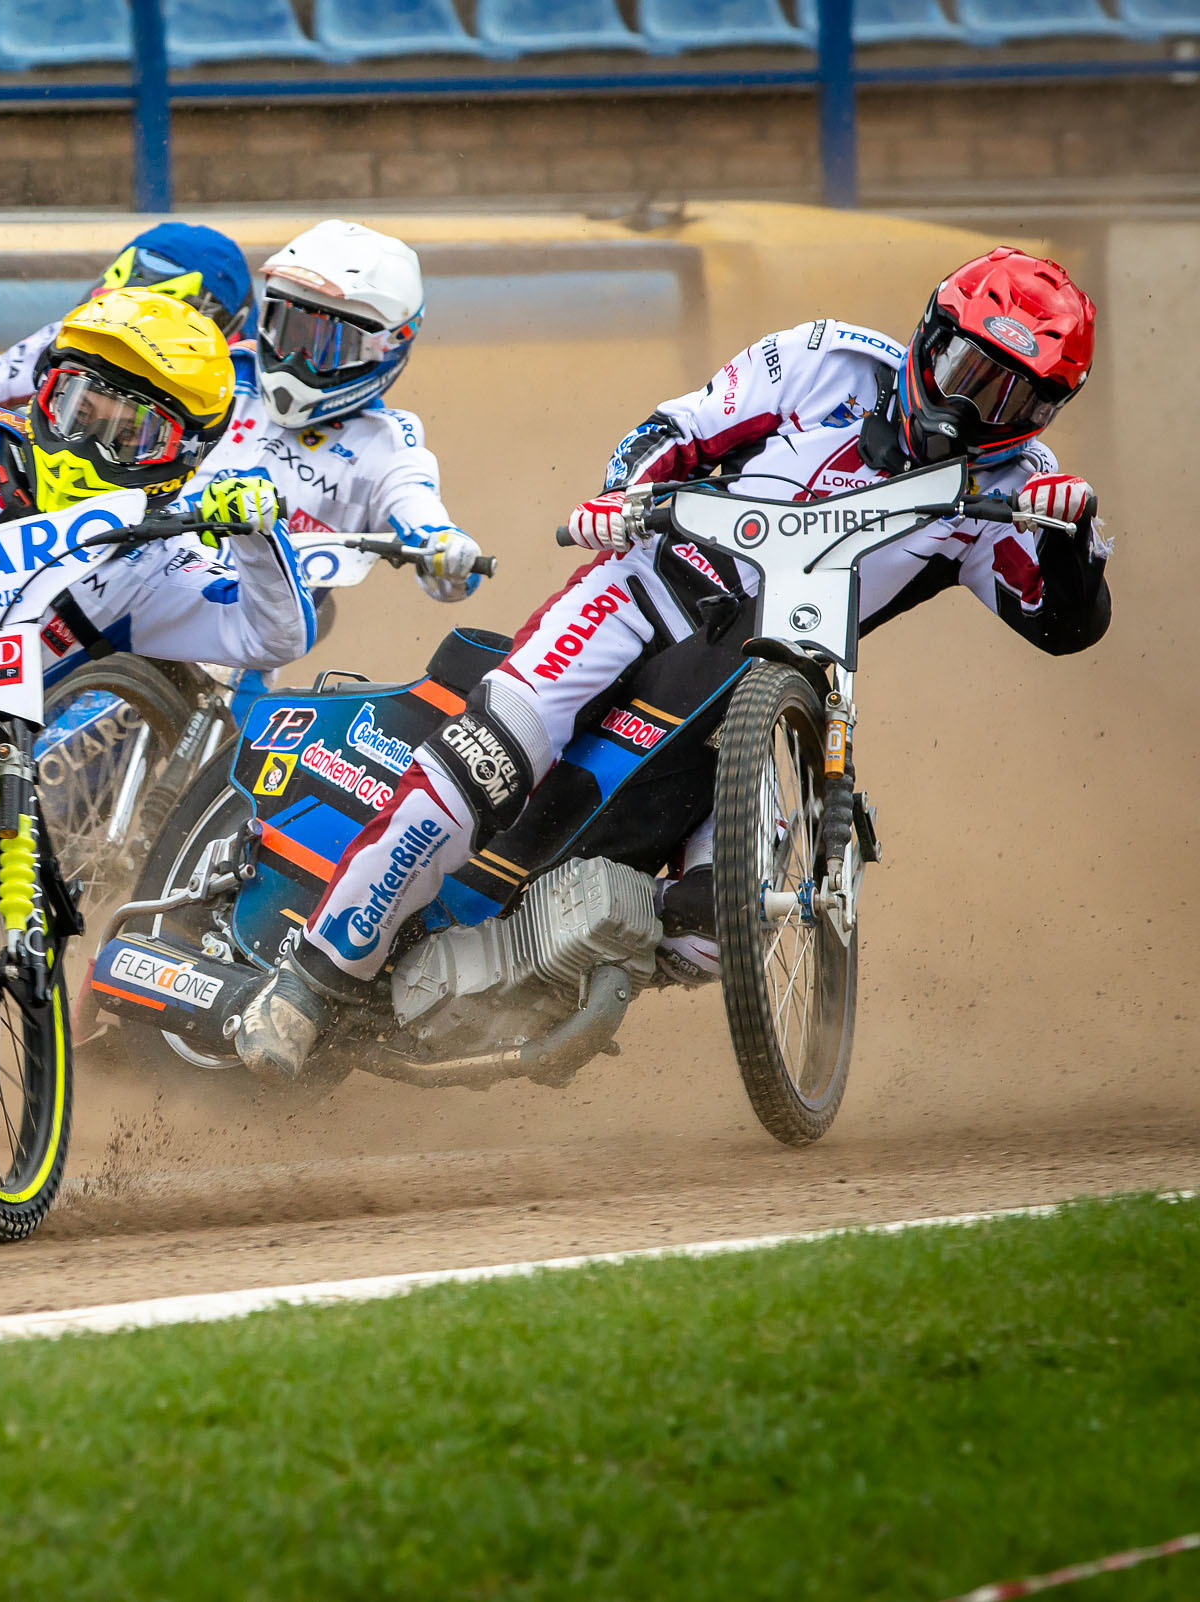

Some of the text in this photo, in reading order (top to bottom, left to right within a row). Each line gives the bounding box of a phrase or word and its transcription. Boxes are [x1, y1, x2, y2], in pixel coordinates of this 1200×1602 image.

[761, 335, 783, 385] TIBET
[836, 330, 906, 361] TROD
[822, 475, 874, 489] LOKO
[778, 509, 890, 537] OPTIBET
[38, 702, 145, 786] OLARO
[251, 708, 317, 750] 12
[357, 722, 414, 768] BarkerBille
[301, 740, 365, 791] dankemi
[357, 776, 393, 810] a/s
[442, 723, 510, 806] CHROM
[473, 726, 519, 784] NIKKEL
[350, 818, 443, 940] BarkerBille
